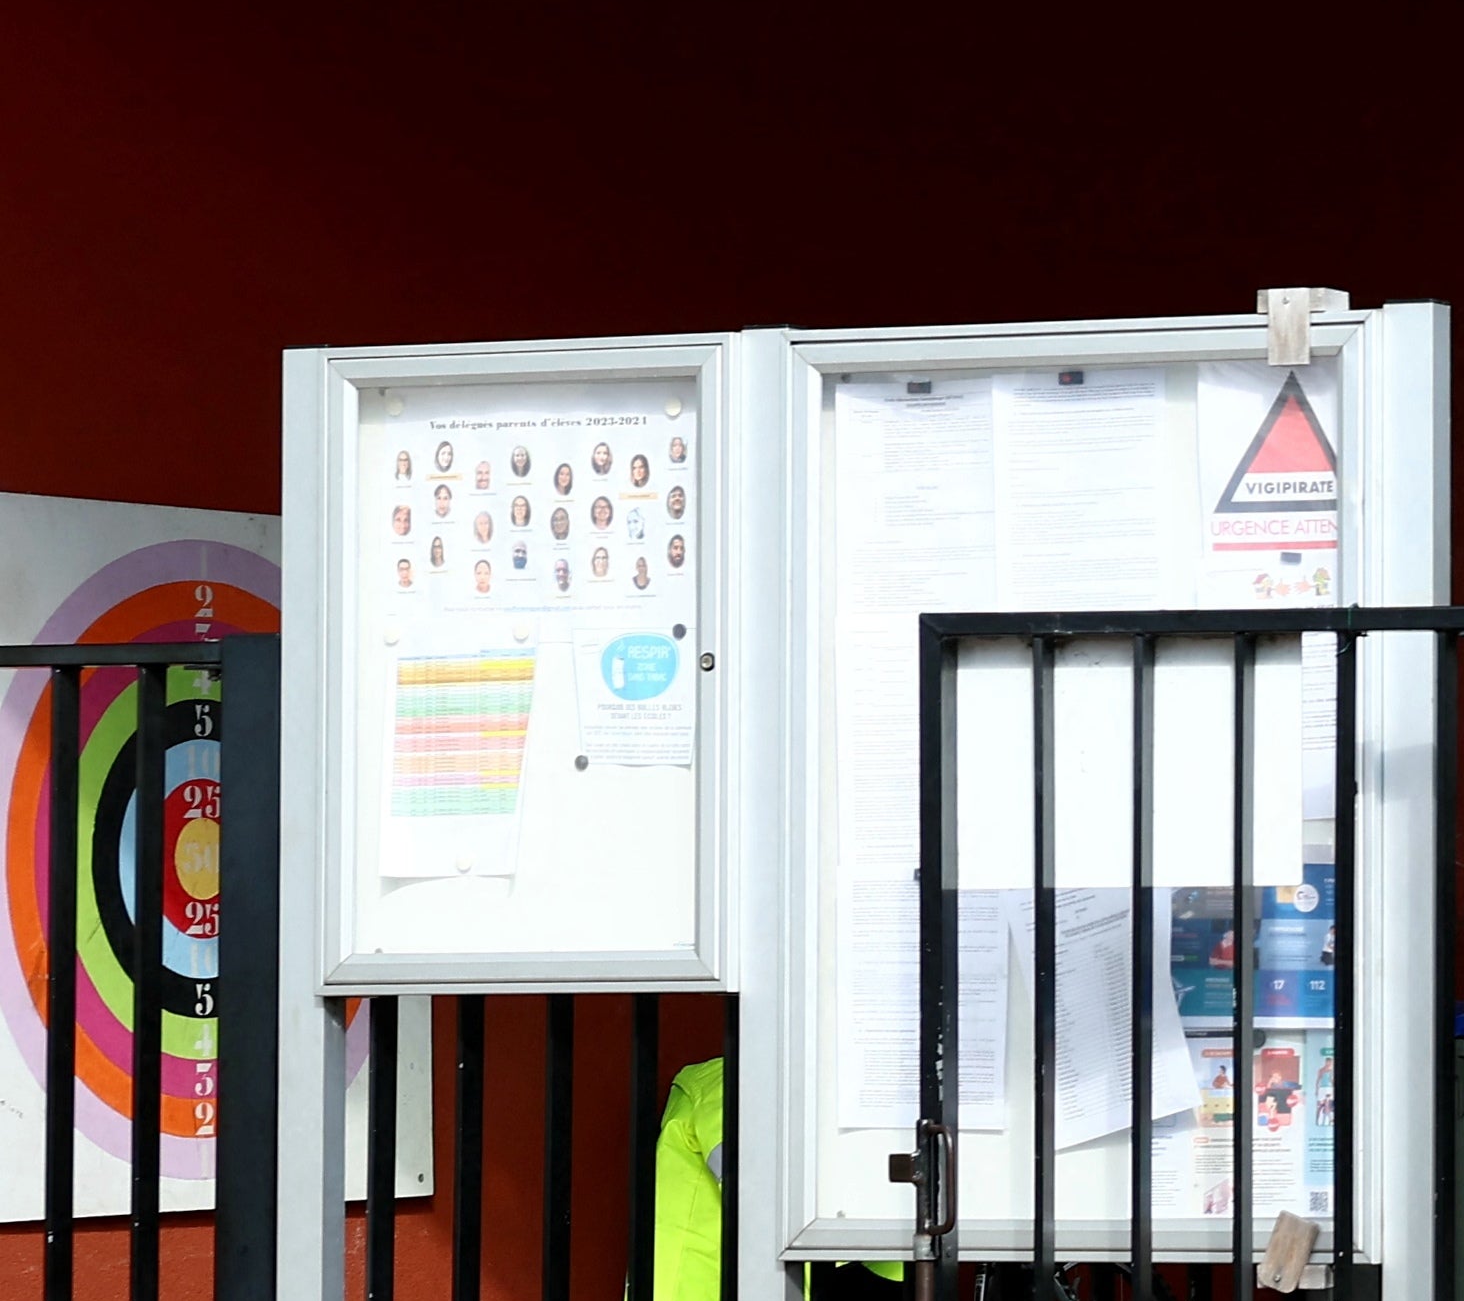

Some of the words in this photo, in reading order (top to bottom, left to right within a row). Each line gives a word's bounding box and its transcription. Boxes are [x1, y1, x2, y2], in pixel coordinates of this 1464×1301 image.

[496, 418, 537, 431] parents
[1244, 480, 1334, 495] VIGIPIRATE
[1210, 519, 1289, 536] URGENCE
[194, 584, 214, 618] 2
[194, 704, 213, 737] 5
[183, 785, 221, 819] 25
[184, 901, 220, 935] 25
[194, 982, 214, 1017] 5
[1272, 979, 1285, 991] 17
[1309, 979, 1326, 991] 112
[194, 1062, 214, 1097] 3
[194, 1101, 215, 1136] 2
